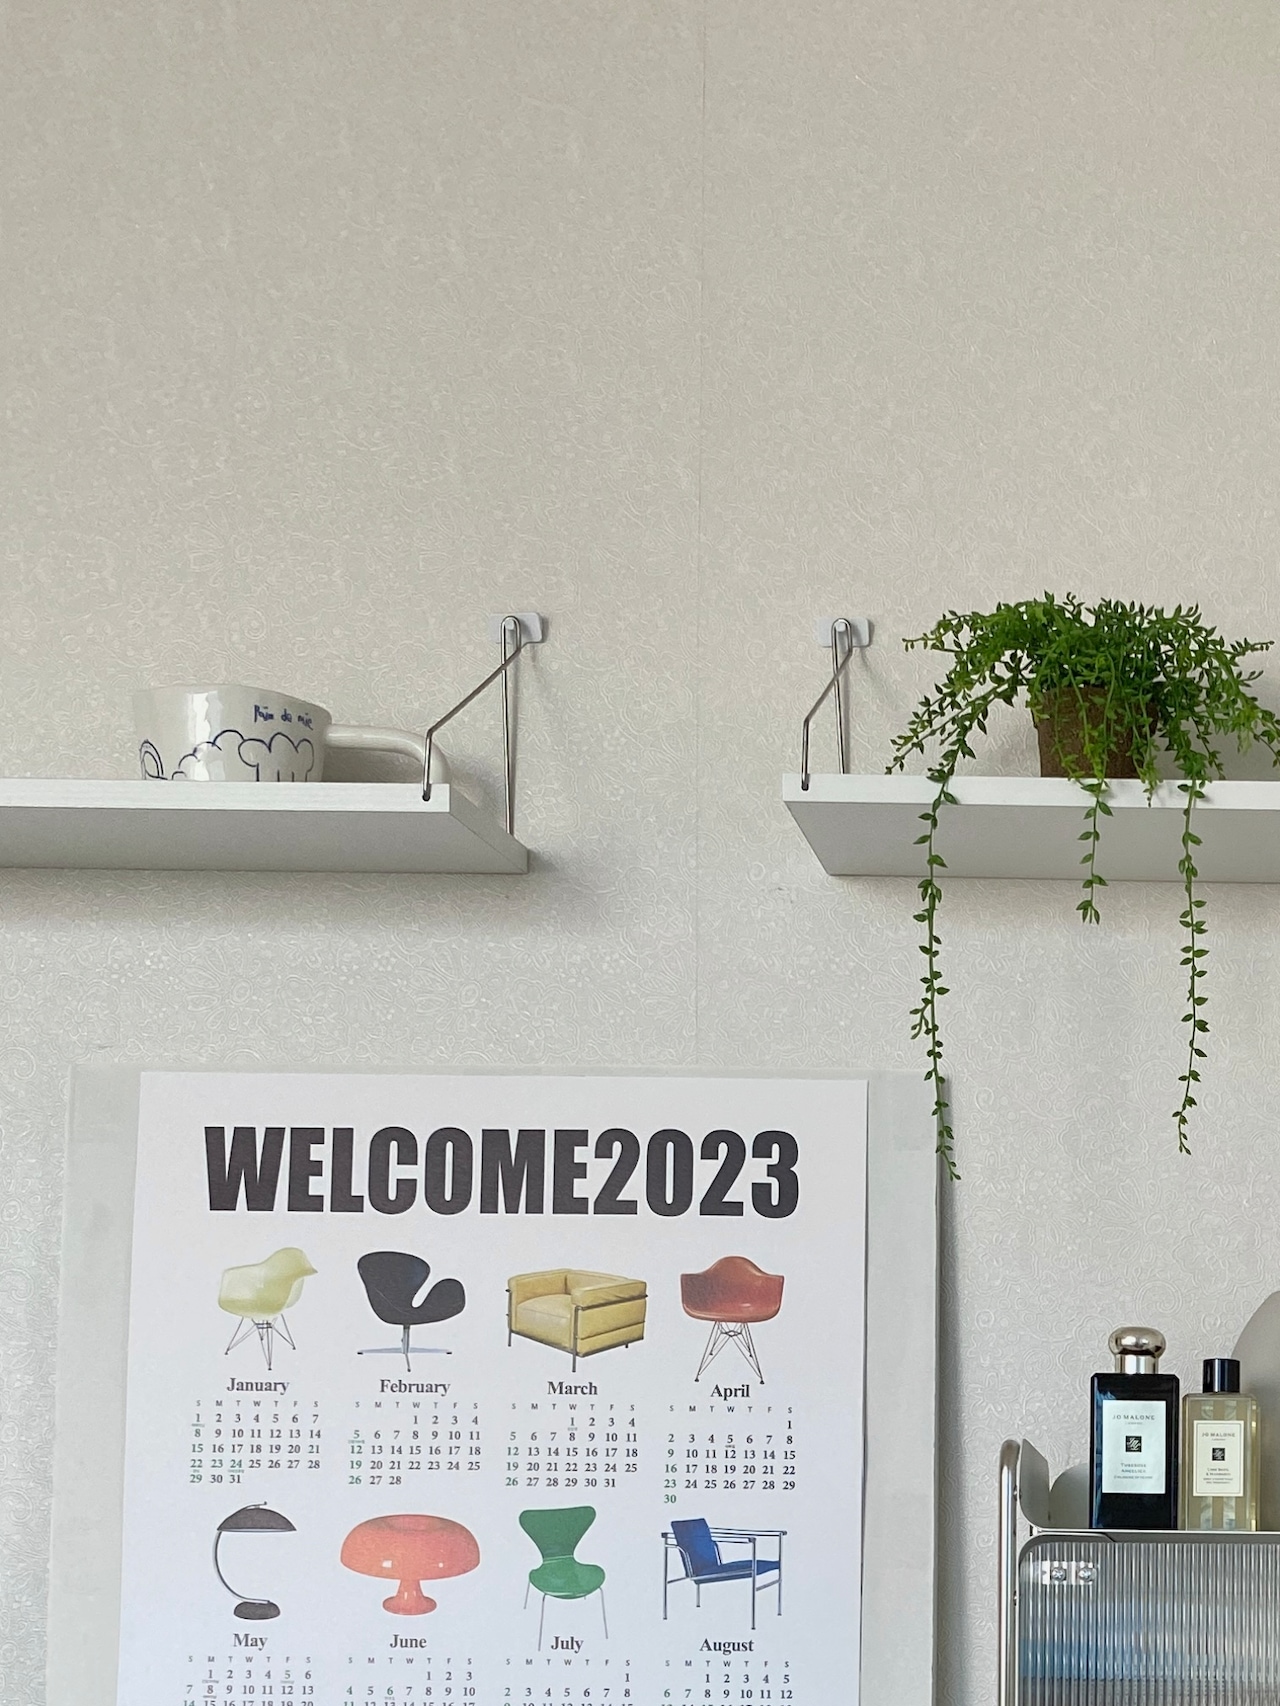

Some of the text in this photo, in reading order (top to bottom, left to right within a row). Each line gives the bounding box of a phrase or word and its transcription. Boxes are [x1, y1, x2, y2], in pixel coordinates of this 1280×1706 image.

[204, 1127, 798, 1218] WELCOME2023
[227, 1378, 289, 1395] January
[381, 1380, 450, 1396] February
[548, 1382, 597, 1395] March
[711, 1385, 749, 1401] April
[668, 1433, 793, 1445] 2 3 4 5 6 7 8
[192, 1443, 320, 1454] 15 16 17 18 19 20 21
[351, 1445, 481, 1456] 12 13 14 15 16 17 18
[507, 1446, 638, 1458] 12 13 14 15 16 17 18
[667, 1448, 796, 1460] 9 10 11 12 13 14 15
[234, 1634, 267, 1651] May
[390, 1635, 426, 1648] June
[551, 1636, 583, 1653] July
[700, 1639, 753, 1655] August
[664, 1688, 793, 1699] 6 7 8 9 10 11 12
